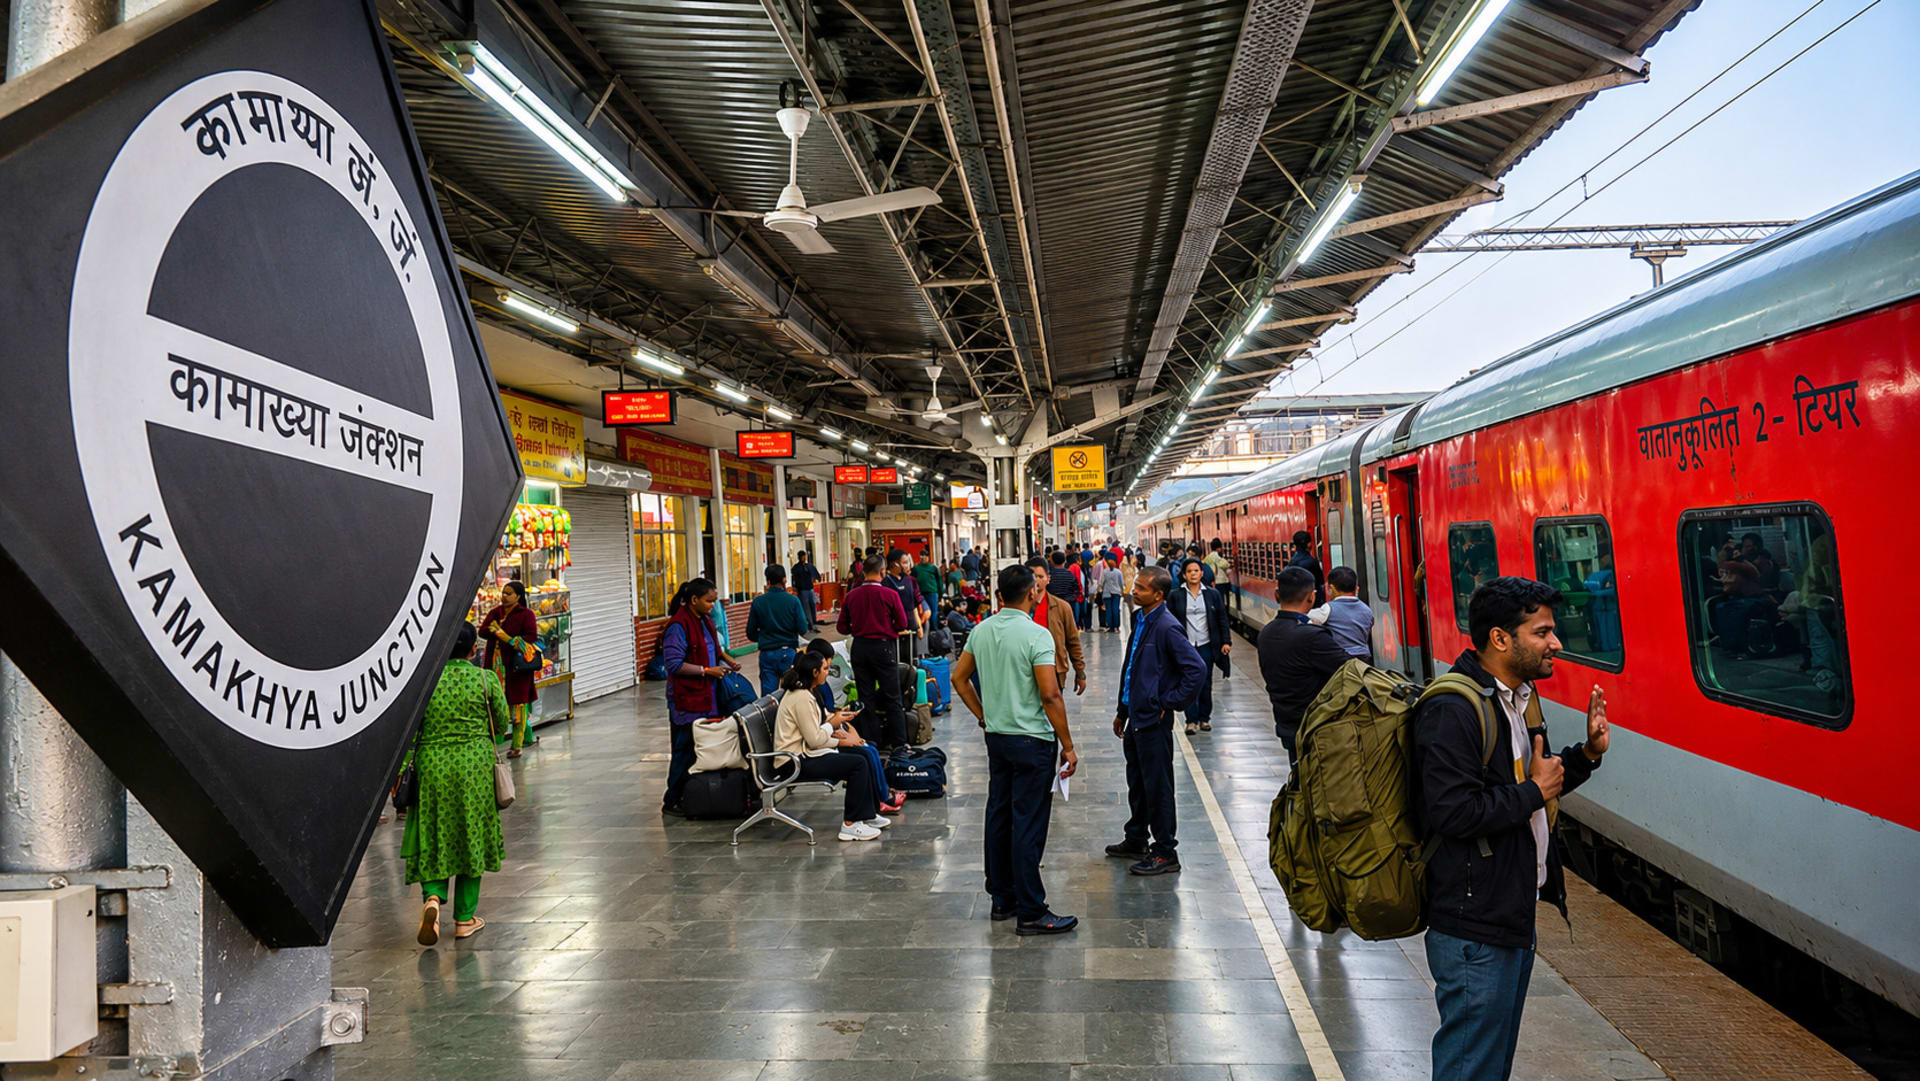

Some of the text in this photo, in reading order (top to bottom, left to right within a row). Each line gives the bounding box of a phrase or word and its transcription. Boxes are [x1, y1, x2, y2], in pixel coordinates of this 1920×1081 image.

[167, 352, 331, 449] कामाख्या
[338, 403, 425, 478] जंक्शन
[1637, 396, 1741, 472] वातानुकूलित
[1792, 374, 1861, 436] टियर
[118, 512, 446, 731] KAMAKHYA JUNCTION
